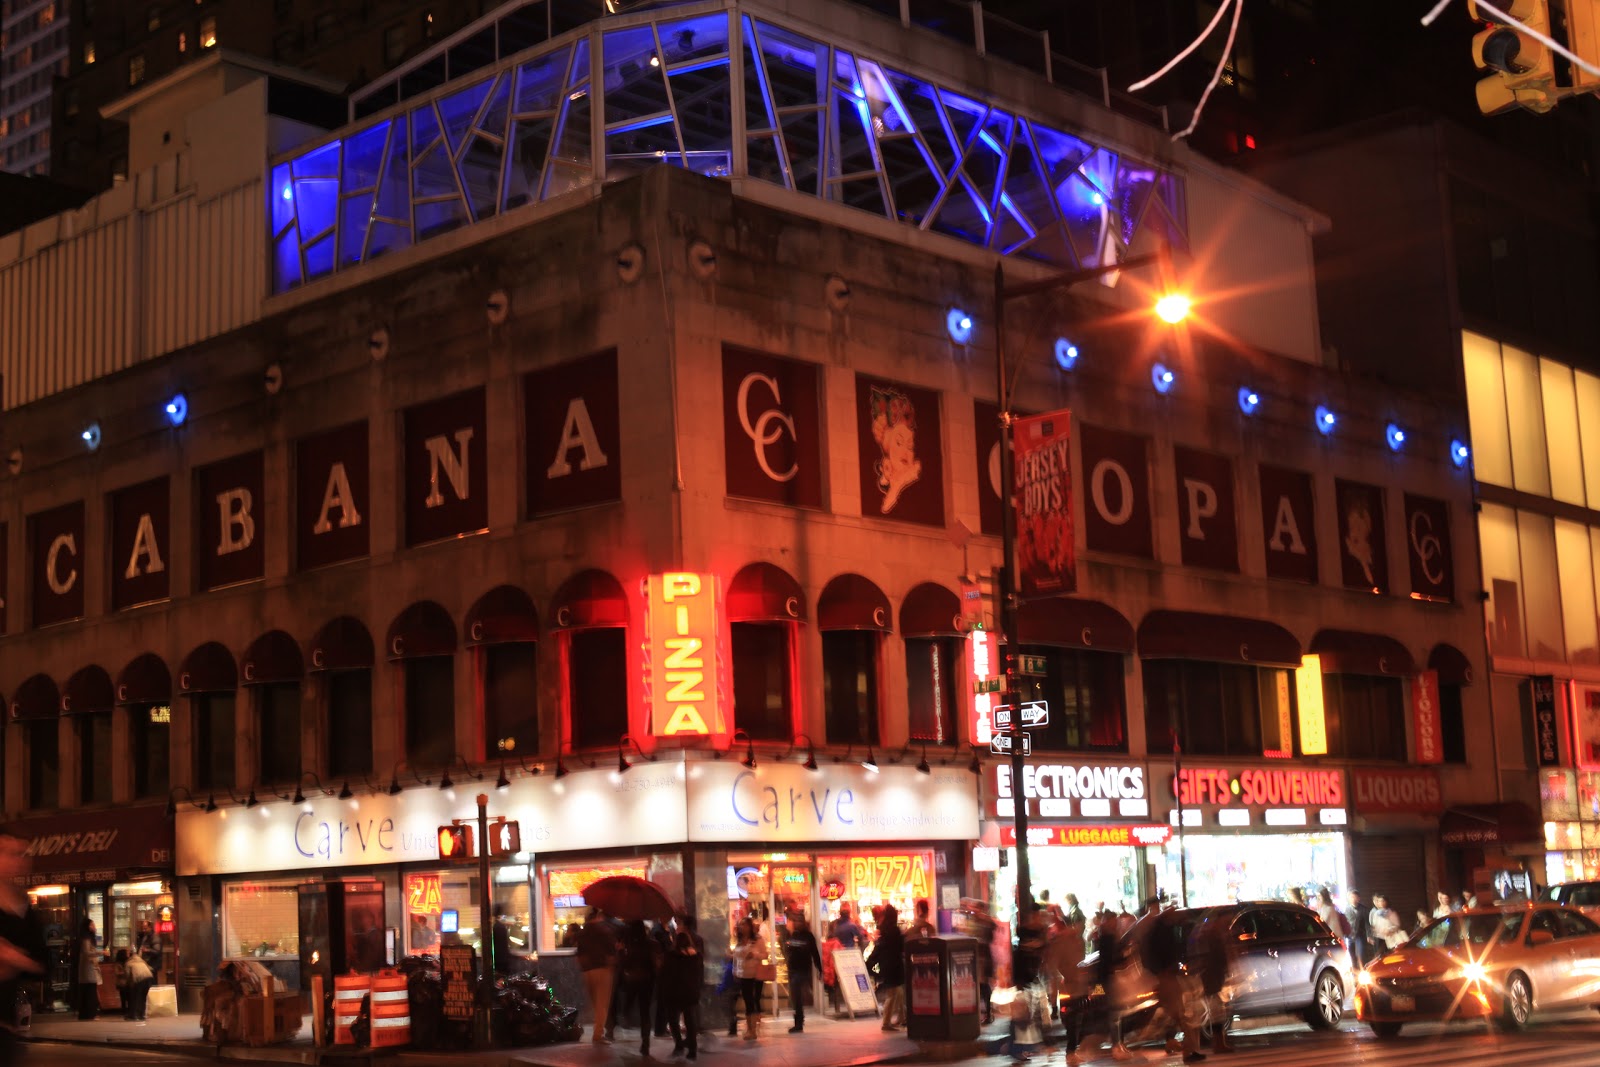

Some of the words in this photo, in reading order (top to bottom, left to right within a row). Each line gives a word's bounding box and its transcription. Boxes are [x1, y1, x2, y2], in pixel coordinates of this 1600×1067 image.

[1016, 439, 1068, 488] JERSEY
[1025, 475, 1062, 517] BOYS
[663, 572, 709, 735] PIZZA
[1028, 657, 1034, 673] 8
[973, 680, 980, 692] W
[981, 680, 990, 691] 47
[1023, 709, 1039, 718] WAY
[1418, 674, 1435, 760] LIQUORS
[996, 739, 1009, 748] ONE
[997, 764, 1144, 798] EECTRONICS
[1173, 767, 1230, 805] GIFTS
[1240, 769, 1341, 805] SOUVENIRS
[1356, 776, 1440, 807] LIQUORS
[731, 770, 854, 830] Carve
[78, 828, 119, 853] DELI
[294, 811, 395, 860] Carve
[1060, 827, 1129, 844] LUGGAGE
[851, 856, 928, 900] PIZZA
